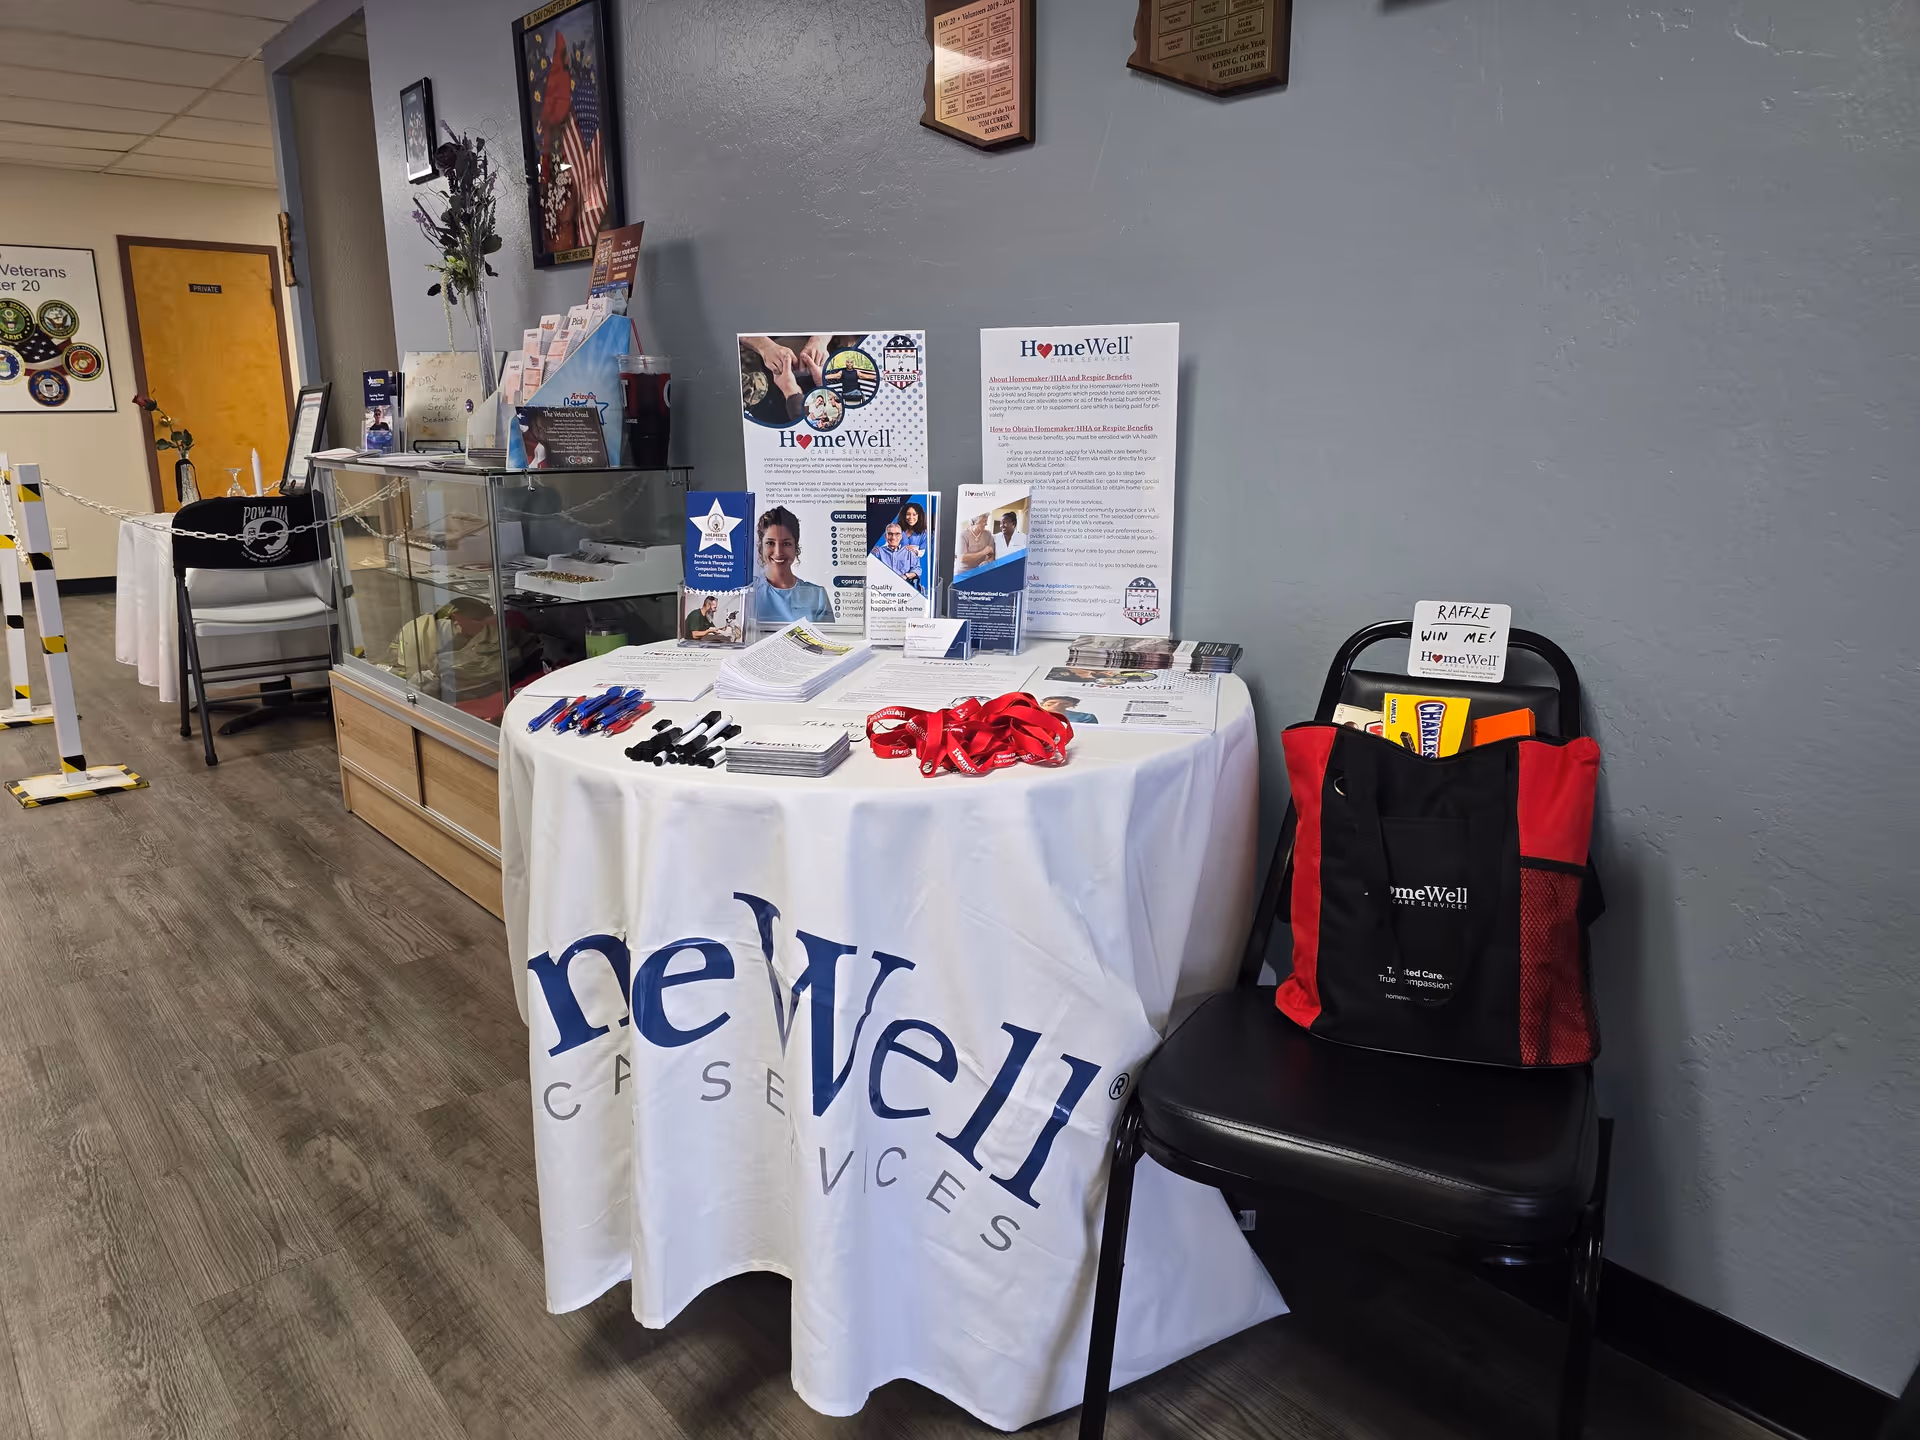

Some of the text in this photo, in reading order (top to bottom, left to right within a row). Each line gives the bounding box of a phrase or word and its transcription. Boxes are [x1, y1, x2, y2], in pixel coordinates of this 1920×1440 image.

[962, 8, 986, 21] Volunteers
[1195, 48, 1232, 63] VOLUNTEERS
[1250, 40, 1266, 48] YEAR
[1239, 50, 1266, 63] COOPER
[1218, 60, 1266, 79] RICHARD PARK
[978, 114, 1010, 128] TOM CURREN
[984, 122, 1014, 134] ROBIN PARK
[0, 264, 66, 279] Veterans
[22, 280, 40, 292] 20
[193, 285, 219, 294] PRIVATE
[571, 316, 584, 326] Pick
[1082, 374, 1105, 382] Respite
[570, 392, 596, 400] Arizona
[542, 410, 553, 418] The
[574, 410, 589, 418] Creed
[1438, 604, 1491, 620] RAFFLE
[1421, 631, 1496, 643] WIN ME!
[802, 720, 835, 728] Take
[1378, 974, 1396, 983] True
[1422, 970, 1444, 980] Care.
